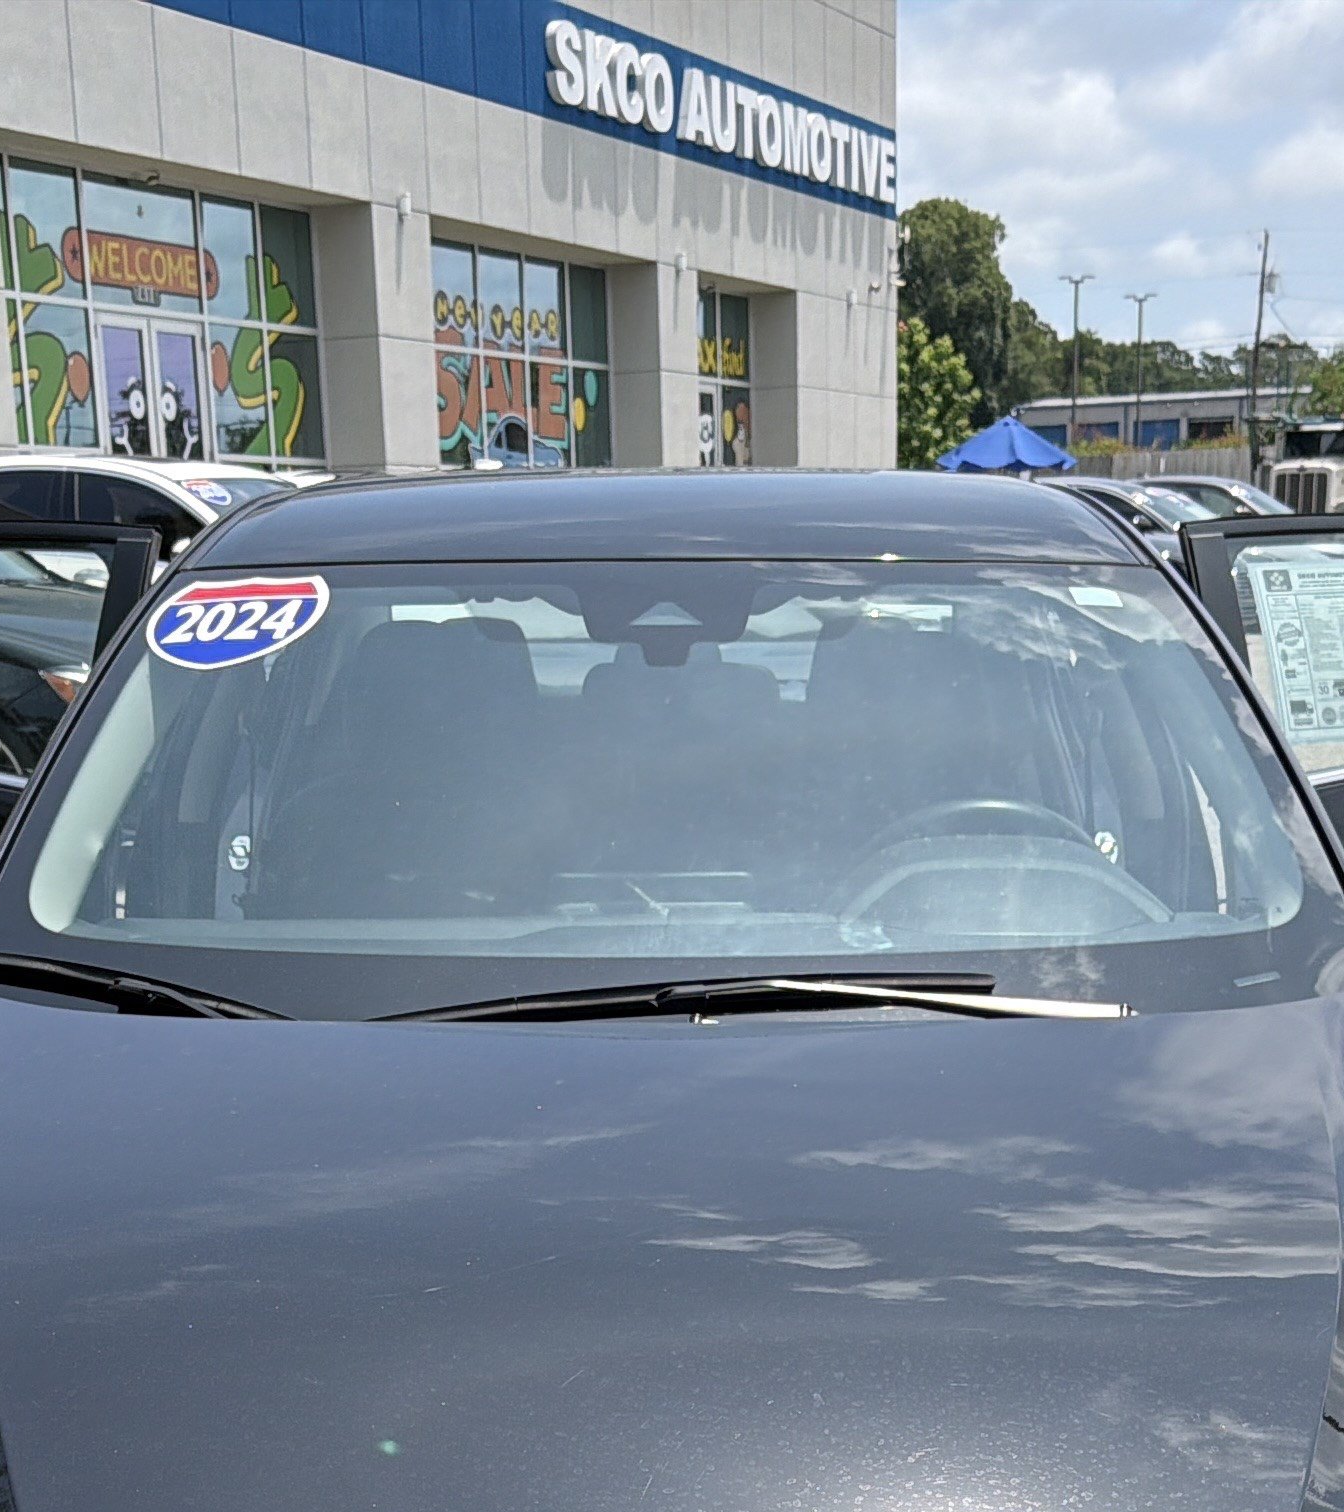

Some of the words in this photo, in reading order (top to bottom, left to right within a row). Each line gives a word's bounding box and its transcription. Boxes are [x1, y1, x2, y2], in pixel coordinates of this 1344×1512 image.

[546, 20, 673, 133] SKCO
[677, 67, 896, 203] AUTOMOTIVE
[90, 240, 198, 291] WELCOME
[160, 600, 303, 644] 2024
